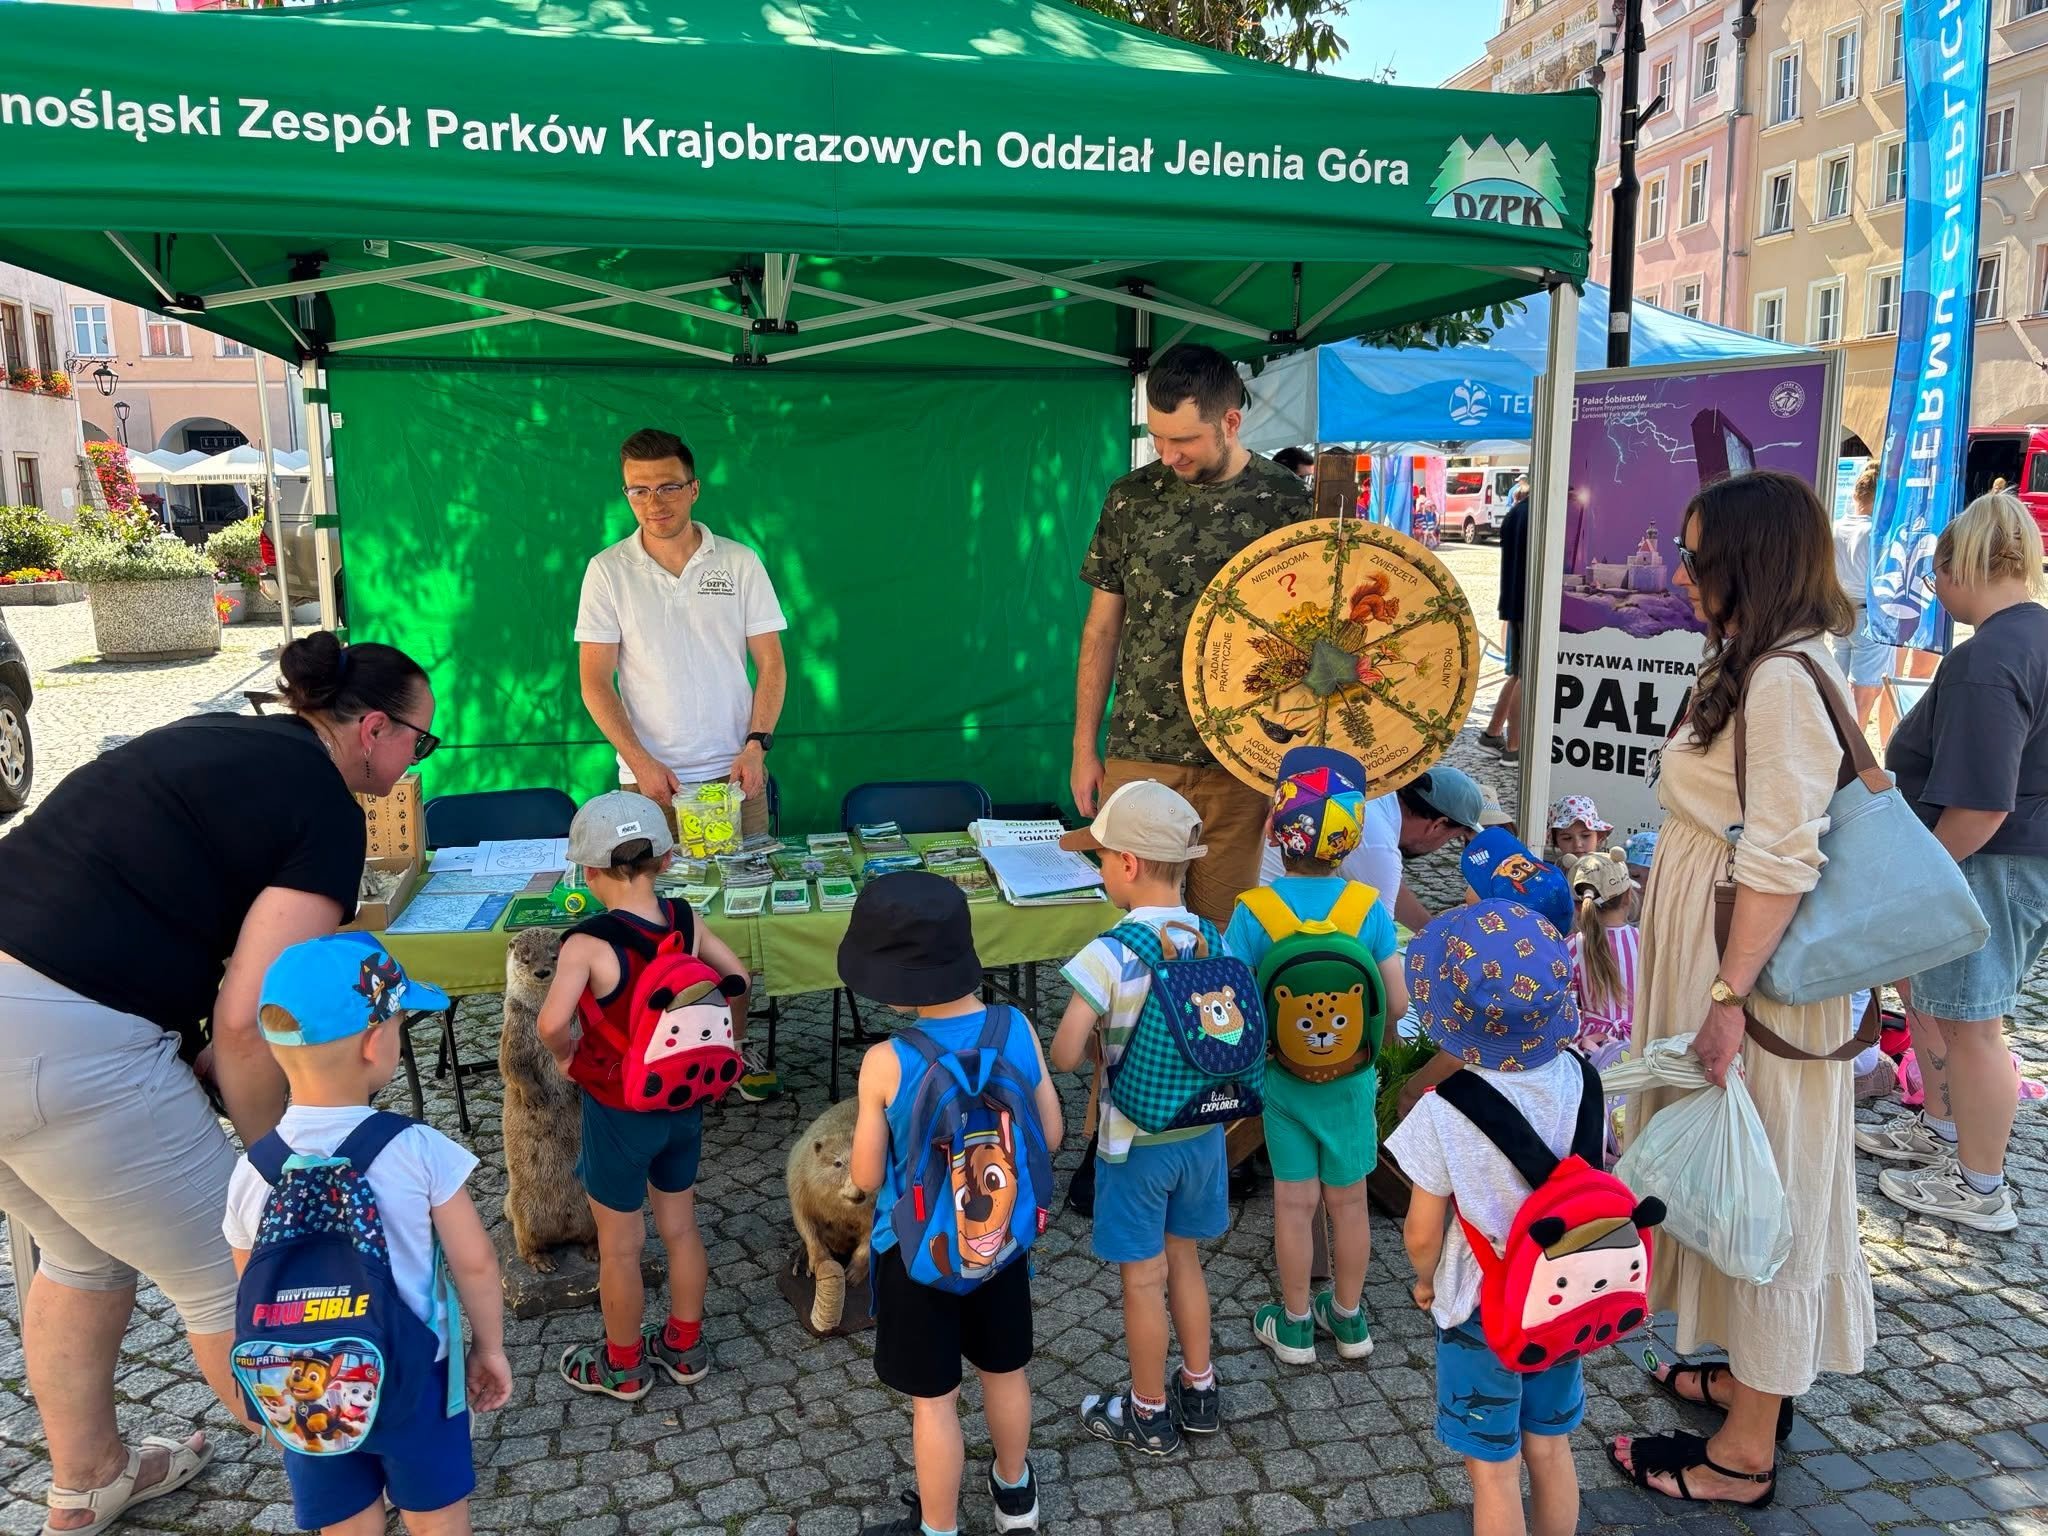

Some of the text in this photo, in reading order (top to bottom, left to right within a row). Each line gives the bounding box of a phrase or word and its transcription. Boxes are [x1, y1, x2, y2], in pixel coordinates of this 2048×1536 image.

[1, 88, 1410, 186] nośląski Zespół Parków Krajobrazowych Oddział Jelenia Góra
[1452, 192, 1546, 227] DZPK
[1582, 393, 1648, 405] Pałac Sobieszów
[1251, 551, 1310, 585] NIEWIADOMA
[1369, 554, 1419, 586] ZWIERZĘTA
[1209, 640, 1221, 681] ZADANIE
[1218, 631, 1233, 693] PRAKTYCZNE
[1442, 648, 1453, 689] ROŚLINY
[1637, 658, 1699, 677] INTERA
[1246, 737, 1284, 765] RZYRODY
[1359, 743, 1389, 761] LEŚNA
[1365, 746, 1410, 771] GOSPODA
[1550, 734, 1660, 778] SOBIE
[1200, 1099, 1240, 1113] EXPLORER
[276, 1284, 352, 1302] ANYTHING IS
[252, 1293, 371, 1328] PAWSIBLE
[235, 1357, 256, 1366] PAW
